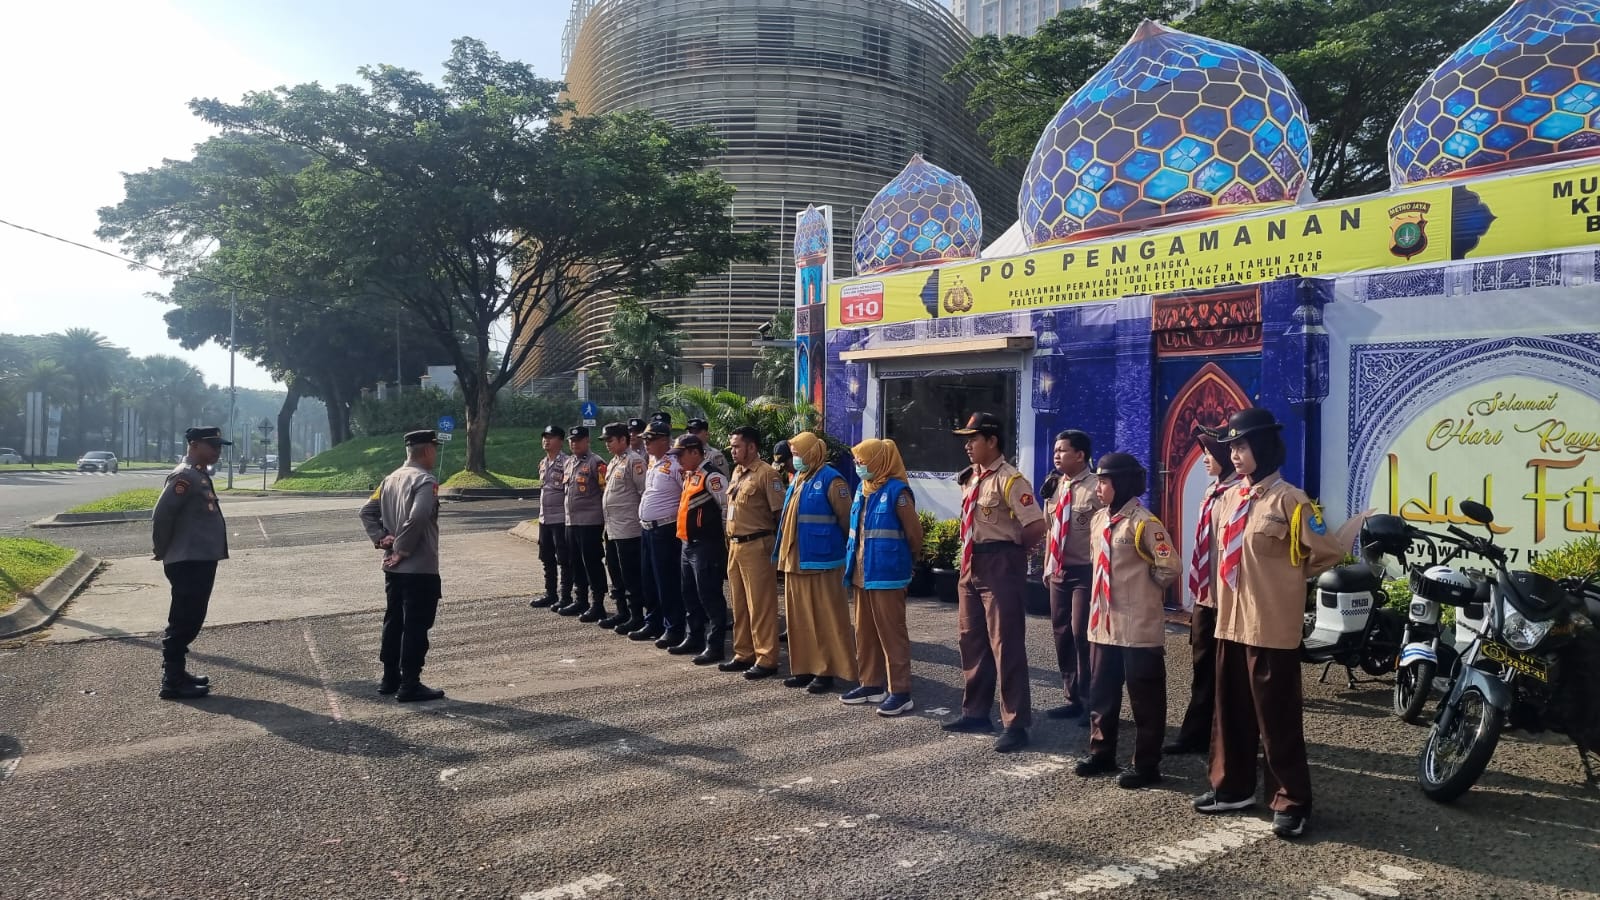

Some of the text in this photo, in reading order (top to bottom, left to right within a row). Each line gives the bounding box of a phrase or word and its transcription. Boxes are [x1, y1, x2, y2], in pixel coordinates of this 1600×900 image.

[1553, 176, 1598, 199] MU
[980, 207, 1361, 282] POS PENGAMANAN
[1008, 250, 1322, 298] PELAYANAN PERAYAAN IDUL FITRI 1447 H TAHUN 2026
[1010, 296, 1044, 307] POLSEK
[1049, 291, 1086, 302] PONDOK
[1092, 287, 1118, 298] AREN
[1134, 280, 1175, 293] POLRES
[1182, 270, 1252, 288] TANGERANG
[1260, 262, 1318, 278] SELATAN
[1105, 258, 1190, 278] DALAM RANGKA
[845, 301, 879, 318] 110
[1467, 392, 1559, 416] Selamat
[1426, 418, 1504, 451] Hari
[1387, 453, 1514, 535] Idul
